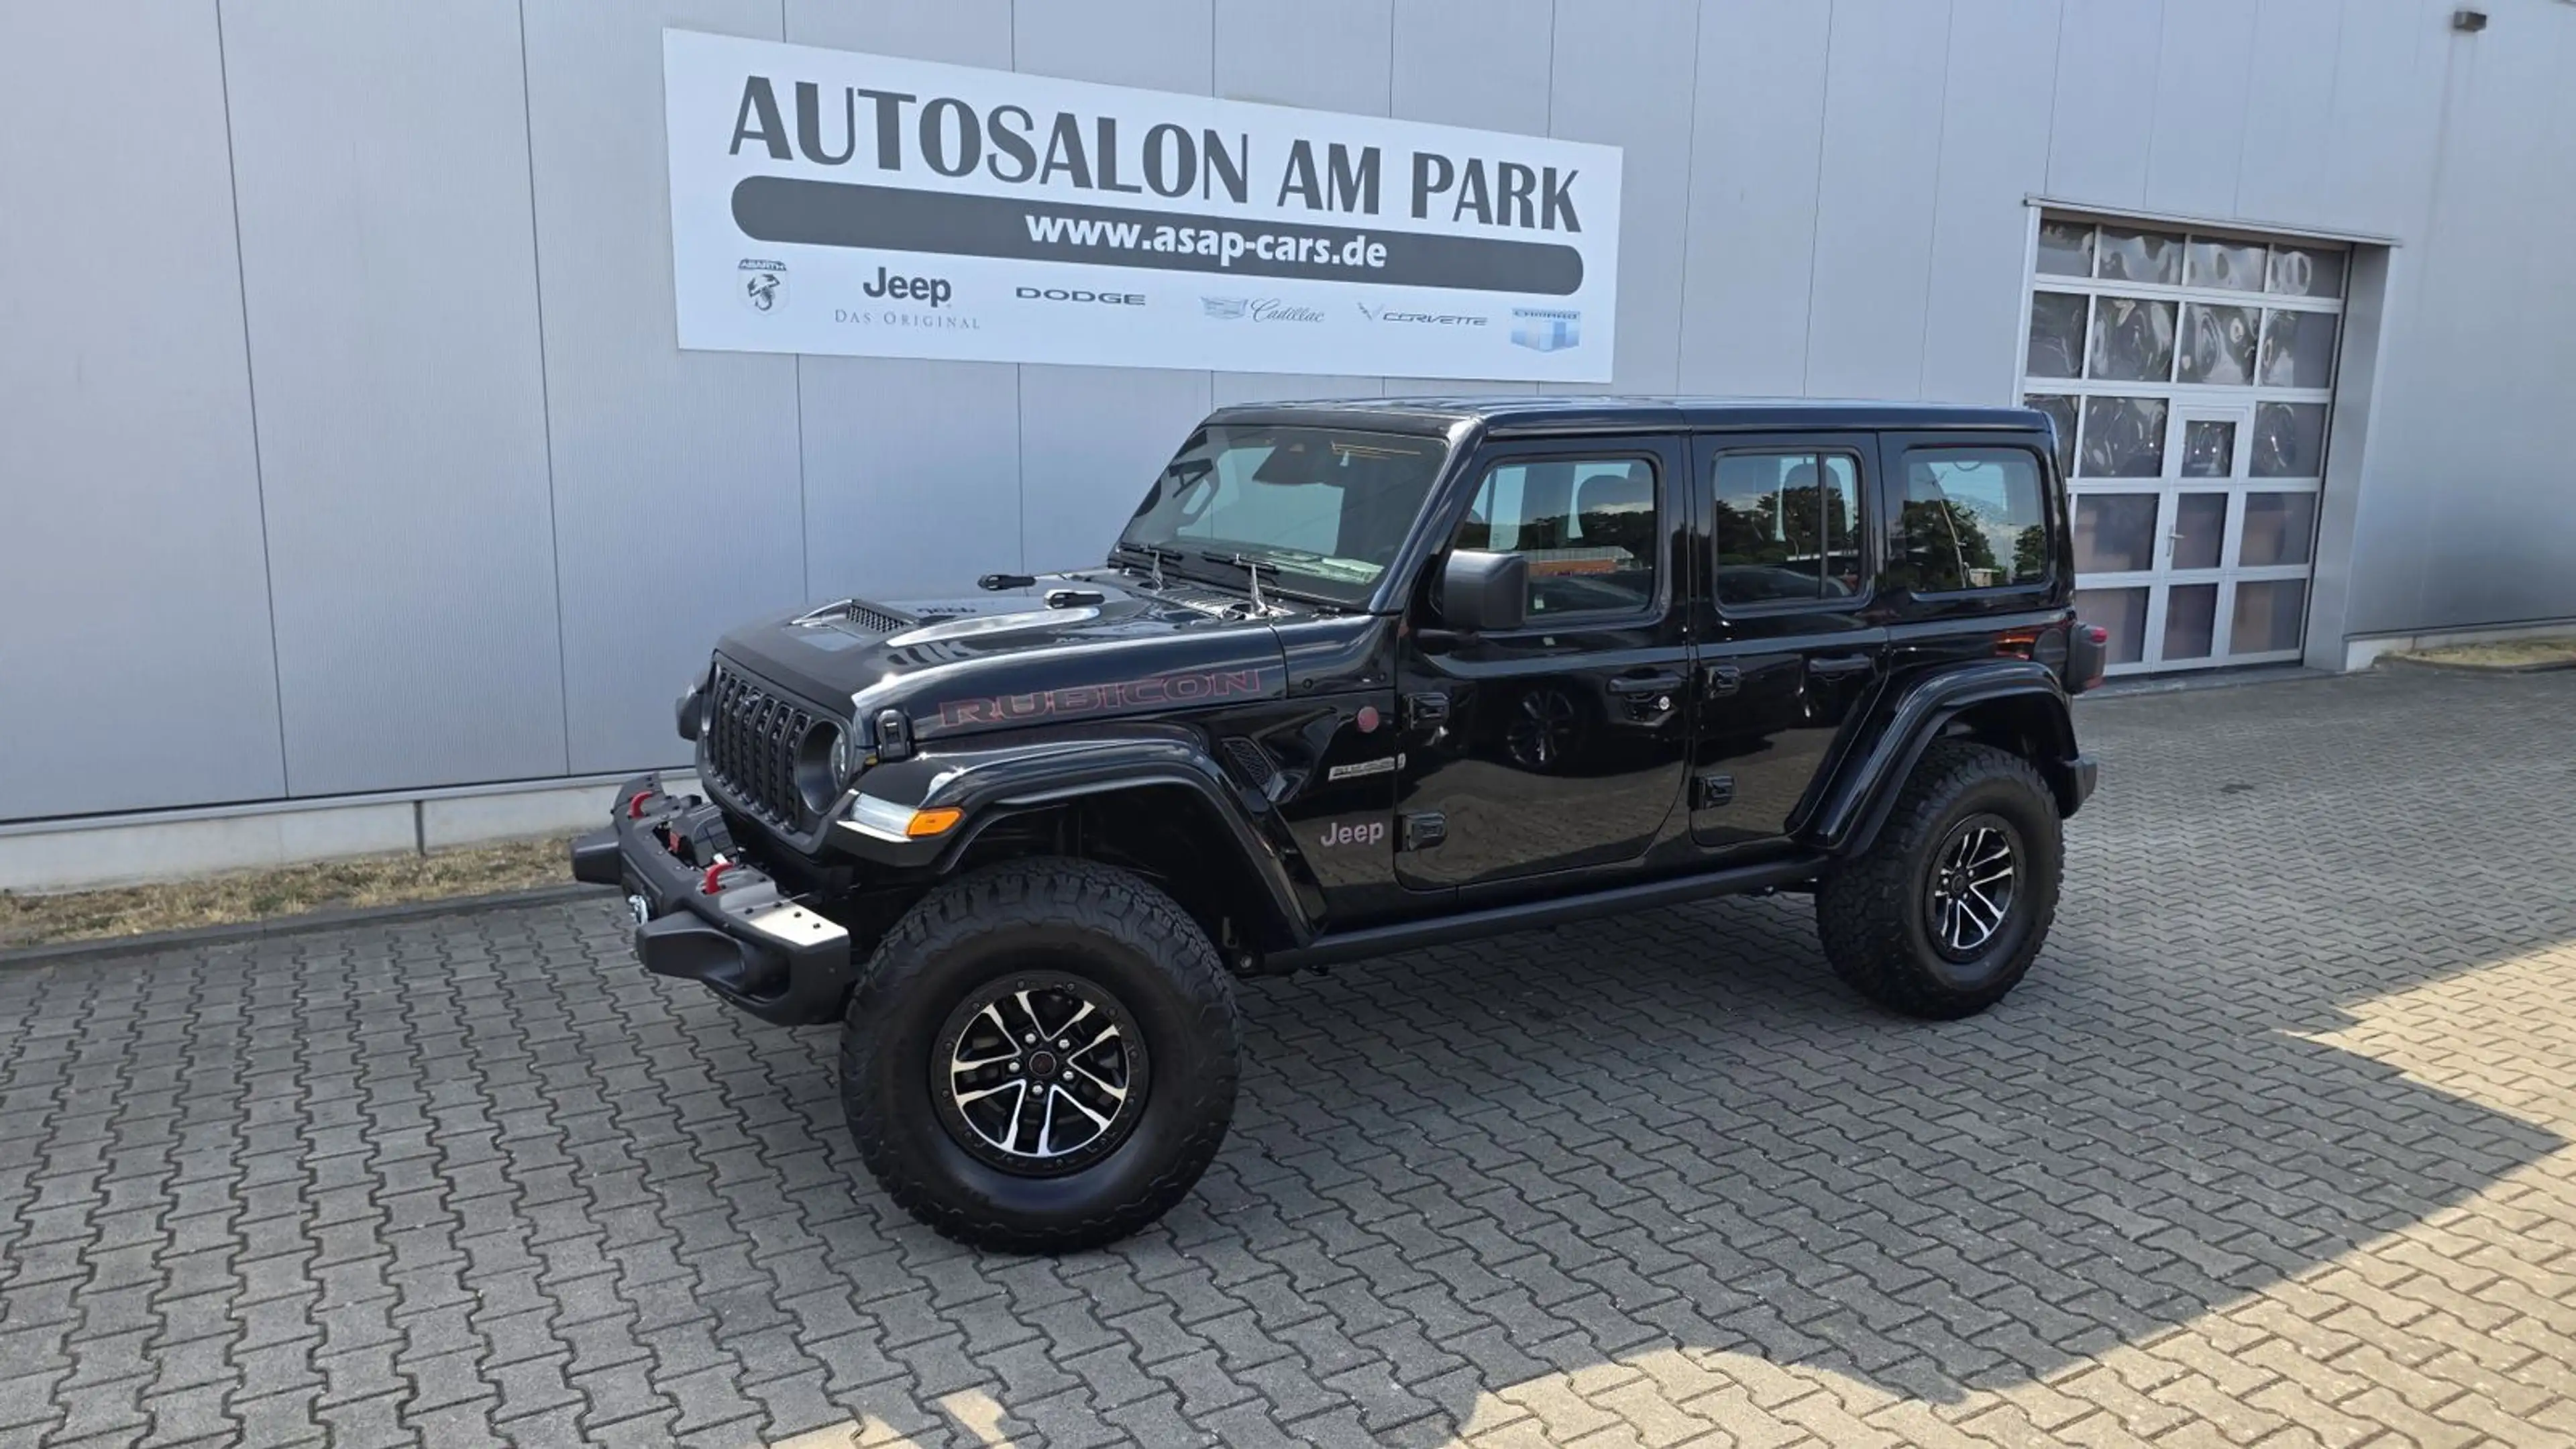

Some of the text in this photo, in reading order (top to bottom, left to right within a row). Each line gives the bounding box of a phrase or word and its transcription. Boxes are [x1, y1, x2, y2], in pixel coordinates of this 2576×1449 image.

[729, 75, 1582, 233] AUTOSALON AM PARK
[1025, 215, 1387, 267] www.asap-cars.de
[863, 266, 951, 308] Jeep
[1016, 287, 1146, 305] DODGE
[1250, 298, 1325, 323] Cadillac
[1383, 312, 1487, 326] CORVETTE
[939, 670, 1263, 727] RUBICON
[1320, 822, 1383, 847] Jeep
